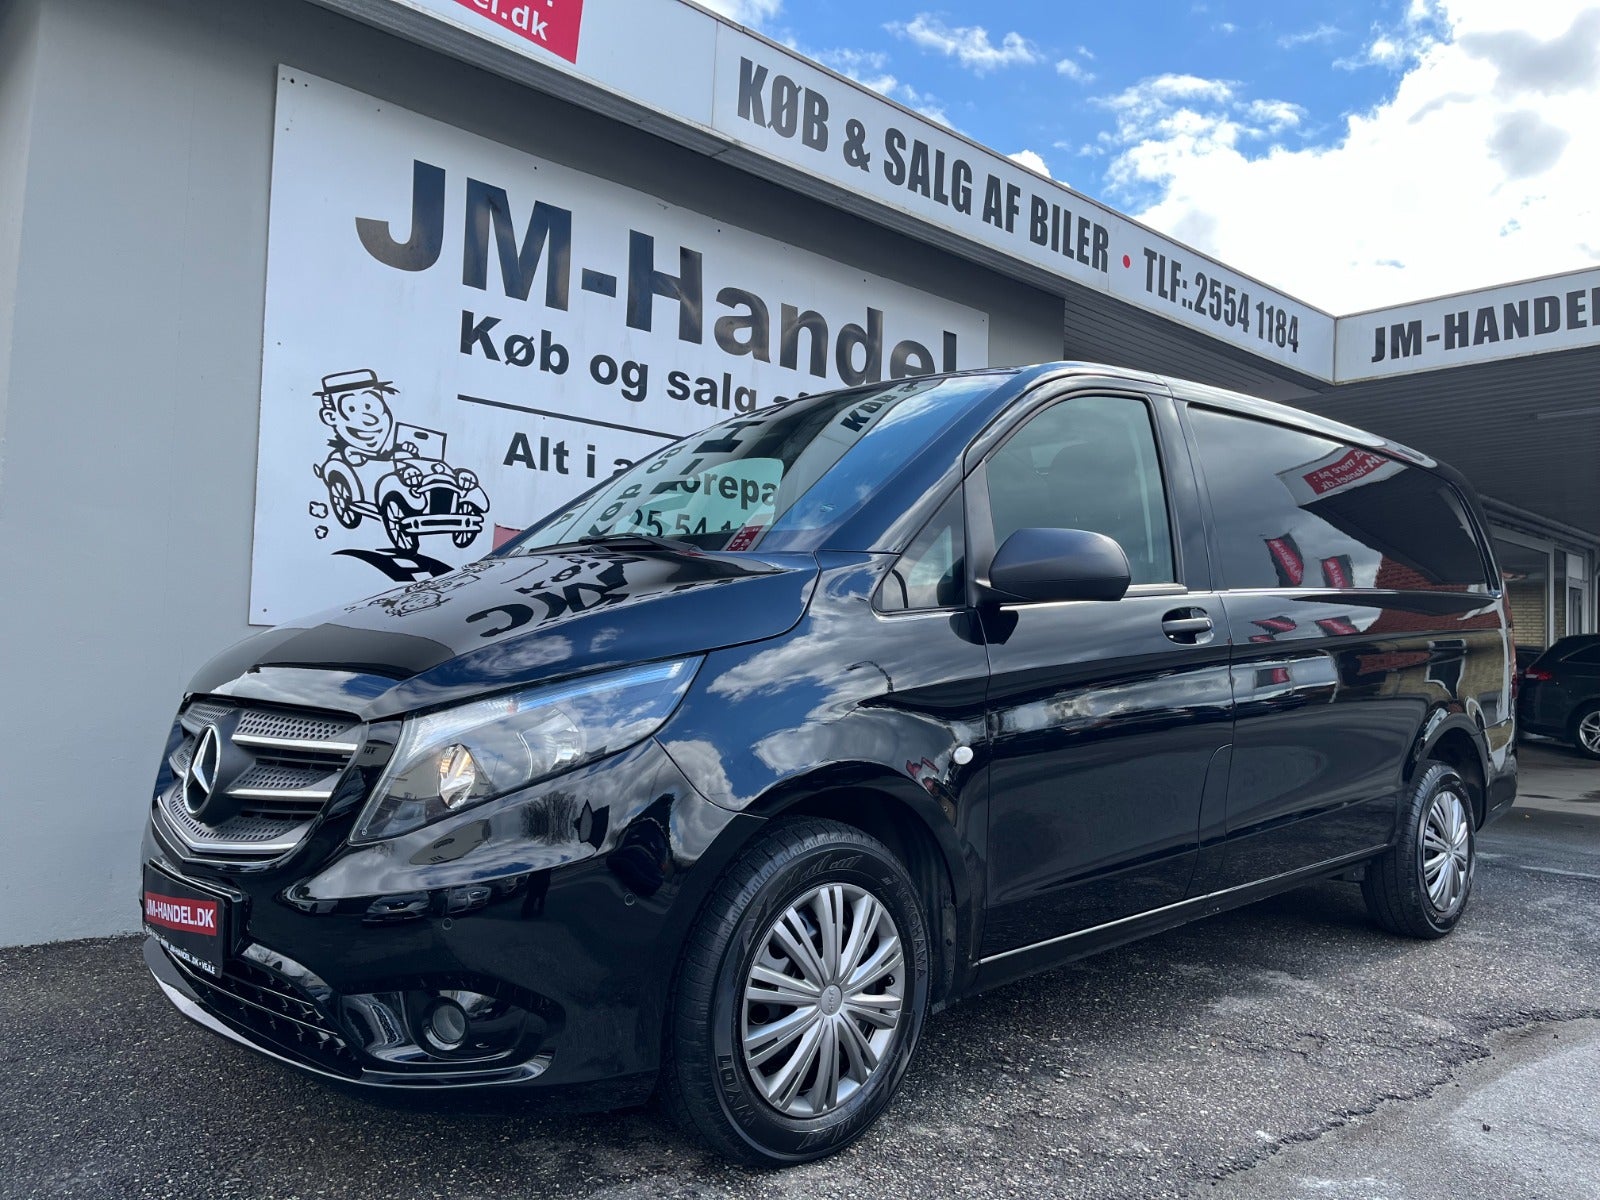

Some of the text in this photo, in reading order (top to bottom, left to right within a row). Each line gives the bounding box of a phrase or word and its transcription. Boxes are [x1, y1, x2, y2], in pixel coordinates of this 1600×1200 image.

[737, 56, 829, 153] KØB
[843, 118, 870, 172] &
[884, 127, 972, 216] SALG
[982, 173, 1021, 234] AF
[1030, 194, 1109, 273] BILER
[1256, 301, 1299, 353] 1184
[355, 159, 957, 387] JM-Handel
[459, 310, 757, 414] Køb og salg
[503, 432, 569, 475] Alt
[586, 444, 596, 479] i
[146, 899, 215, 928] JM-HANDEL.DK
